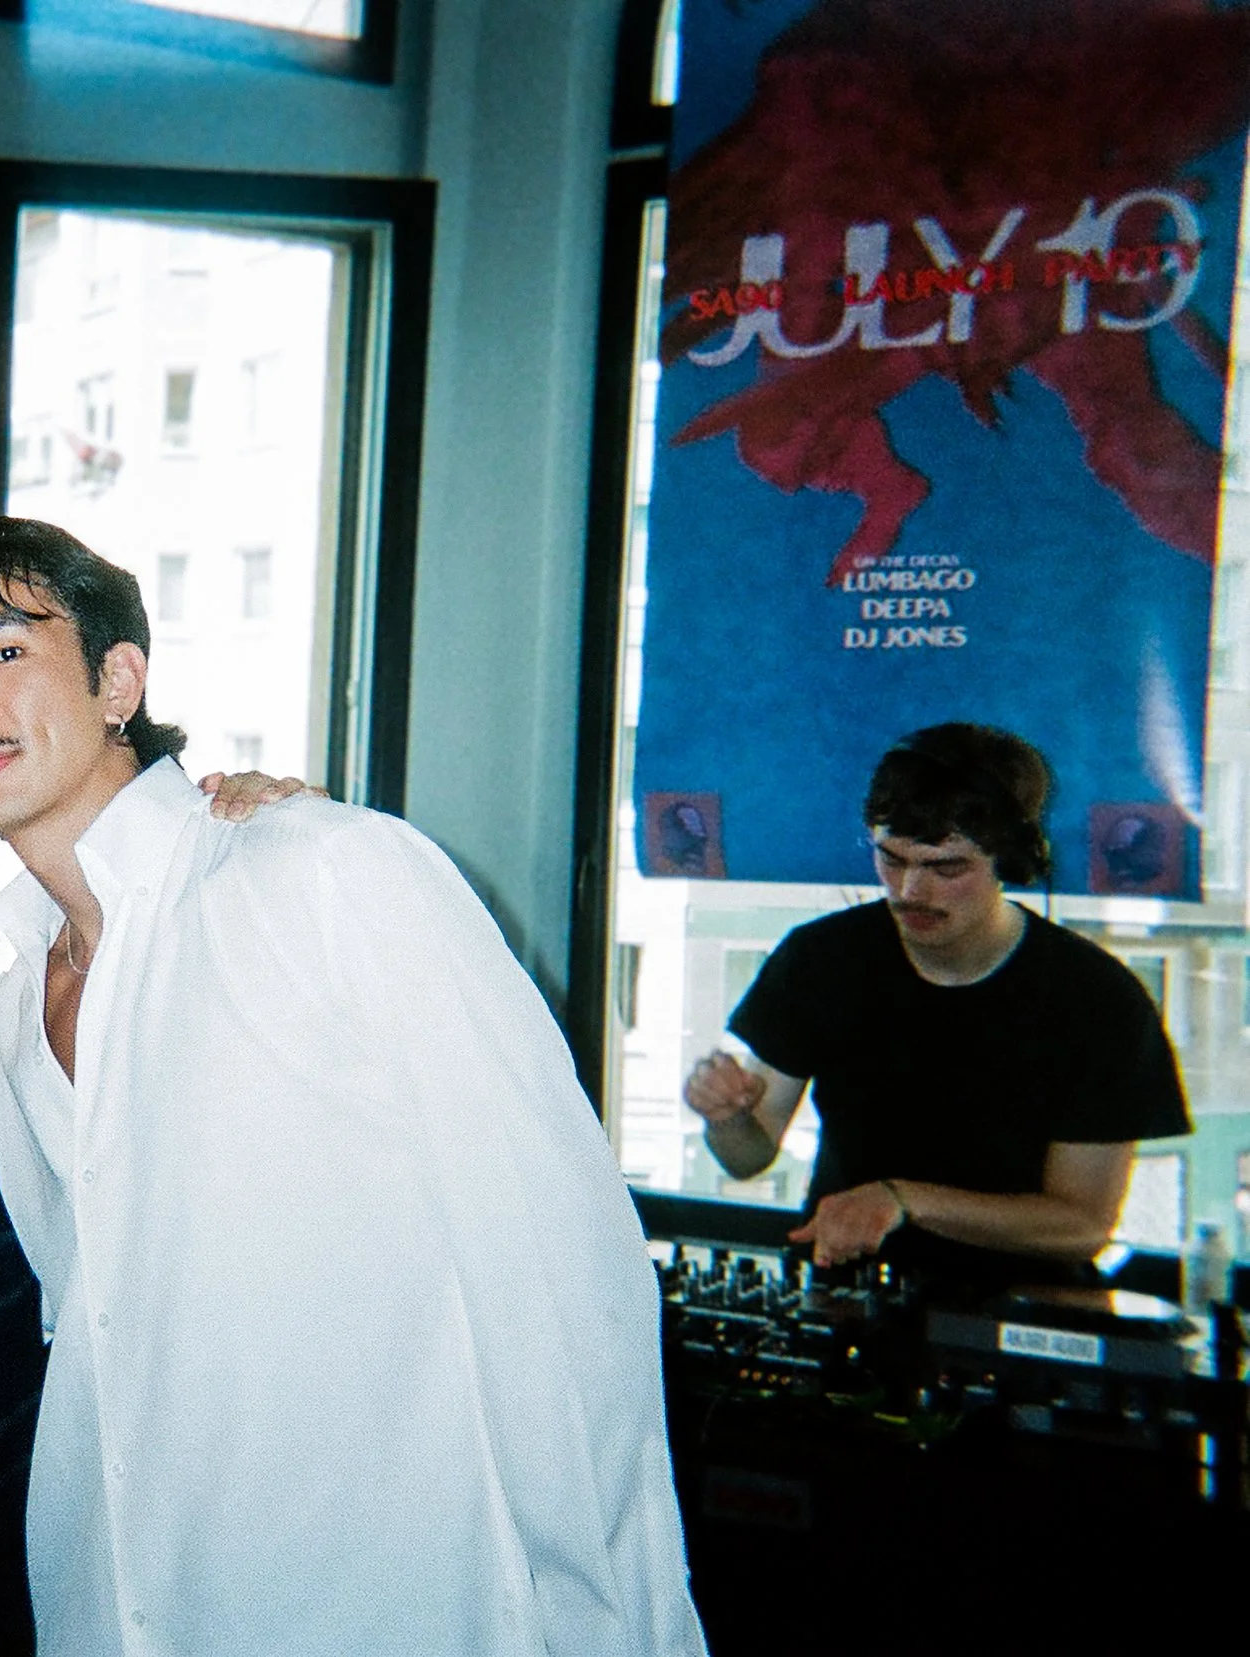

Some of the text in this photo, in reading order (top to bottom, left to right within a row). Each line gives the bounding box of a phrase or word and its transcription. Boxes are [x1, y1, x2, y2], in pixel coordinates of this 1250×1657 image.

[686, 187, 1203, 367] JULY 19
[843, 258, 1015, 306] LAUNCH
[1044, 241, 1203, 288] PARTY
[881, 555, 906, 568] THE
[909, 554, 960, 568] DECKS
[842, 568, 976, 592] LUMBAGO
[861, 597, 952, 620] DEEPA
[844, 625, 968, 649] DJ JONES
